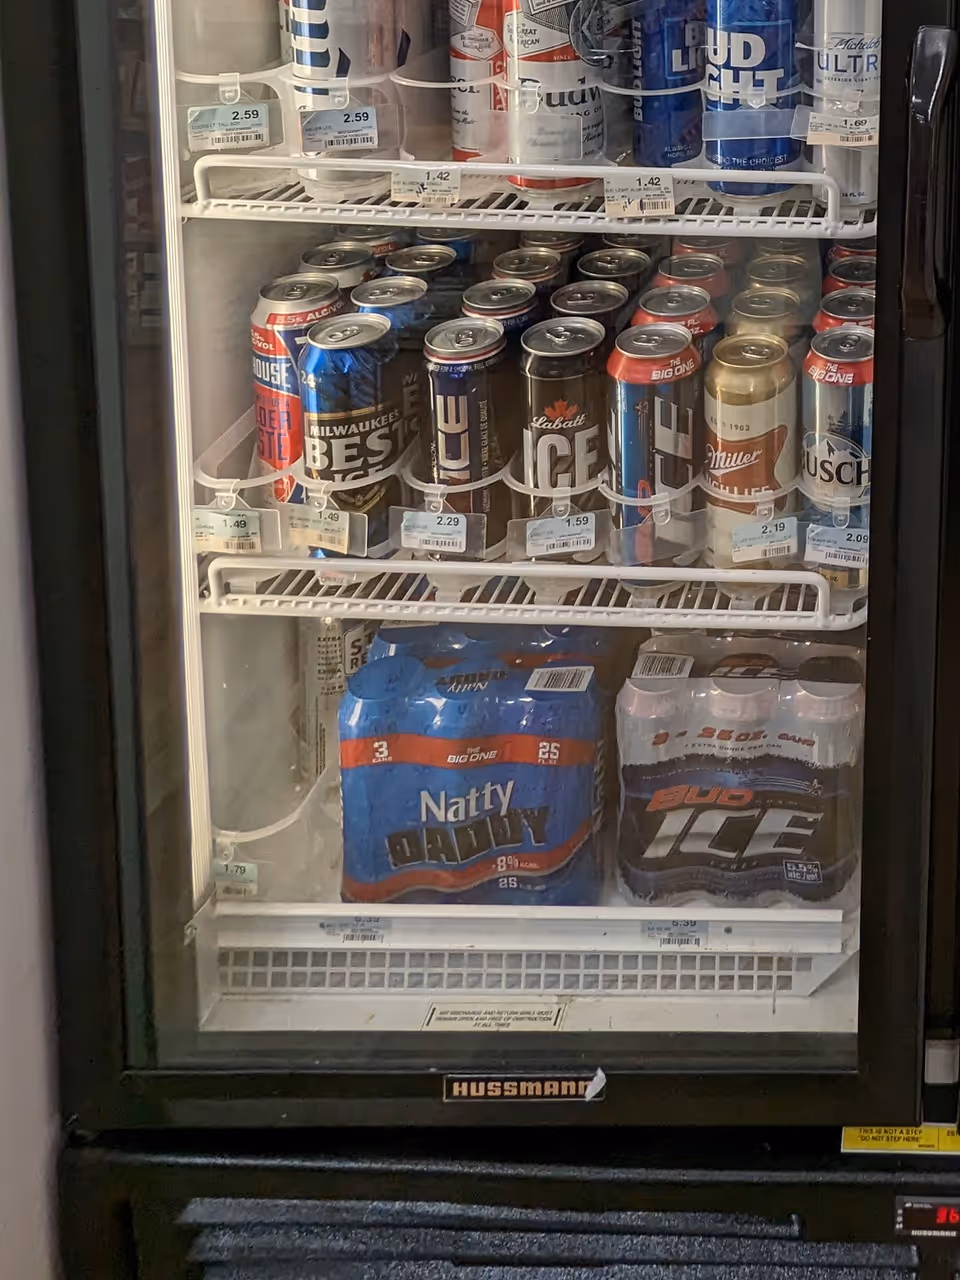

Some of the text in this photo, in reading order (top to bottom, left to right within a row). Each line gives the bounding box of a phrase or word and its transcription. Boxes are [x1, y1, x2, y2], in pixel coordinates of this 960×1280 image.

[706, 27, 766, 68] UD
[816, 53, 879, 73] ULTR
[632, 22, 643, 121] BUD LIGHT
[232, 109, 260, 121] 2.59
[344, 111, 369, 123] 2.59
[842, 118, 868, 127] 1.69
[732, 157, 747, 166] THE
[425, 170, 450, 182] 1.42
[636, 176, 661, 187] 1.42
[670, 357, 681, 367] THE
[825, 362, 838, 372] THE
[651, 359, 696, 381] BIG ONE
[824, 370, 854, 384] ONE
[531, 413, 587, 430] Labatt
[729, 423, 751, 432] 1903
[522, 423, 600, 491] ICE
[706, 445, 763, 470] Miller
[318, 511, 339, 522] 1.49
[436, 516, 459, 527] 2.29
[565, 516, 589, 528] 1.59
[223, 518, 247, 529] 1.49
[761, 522, 786, 534] 2.19
[846, 532, 868, 544] 2.09
[373, 740, 389, 758] 3
[538, 740, 561, 759] 25
[446, 749, 498, 763] BIG ONE
[420, 779, 514, 823] Natty
[646, 783, 754, 812] BUD
[385, 804, 549, 870] DADDY
[641, 806, 824, 860] ICE
[223, 864, 246, 876] 1.79
